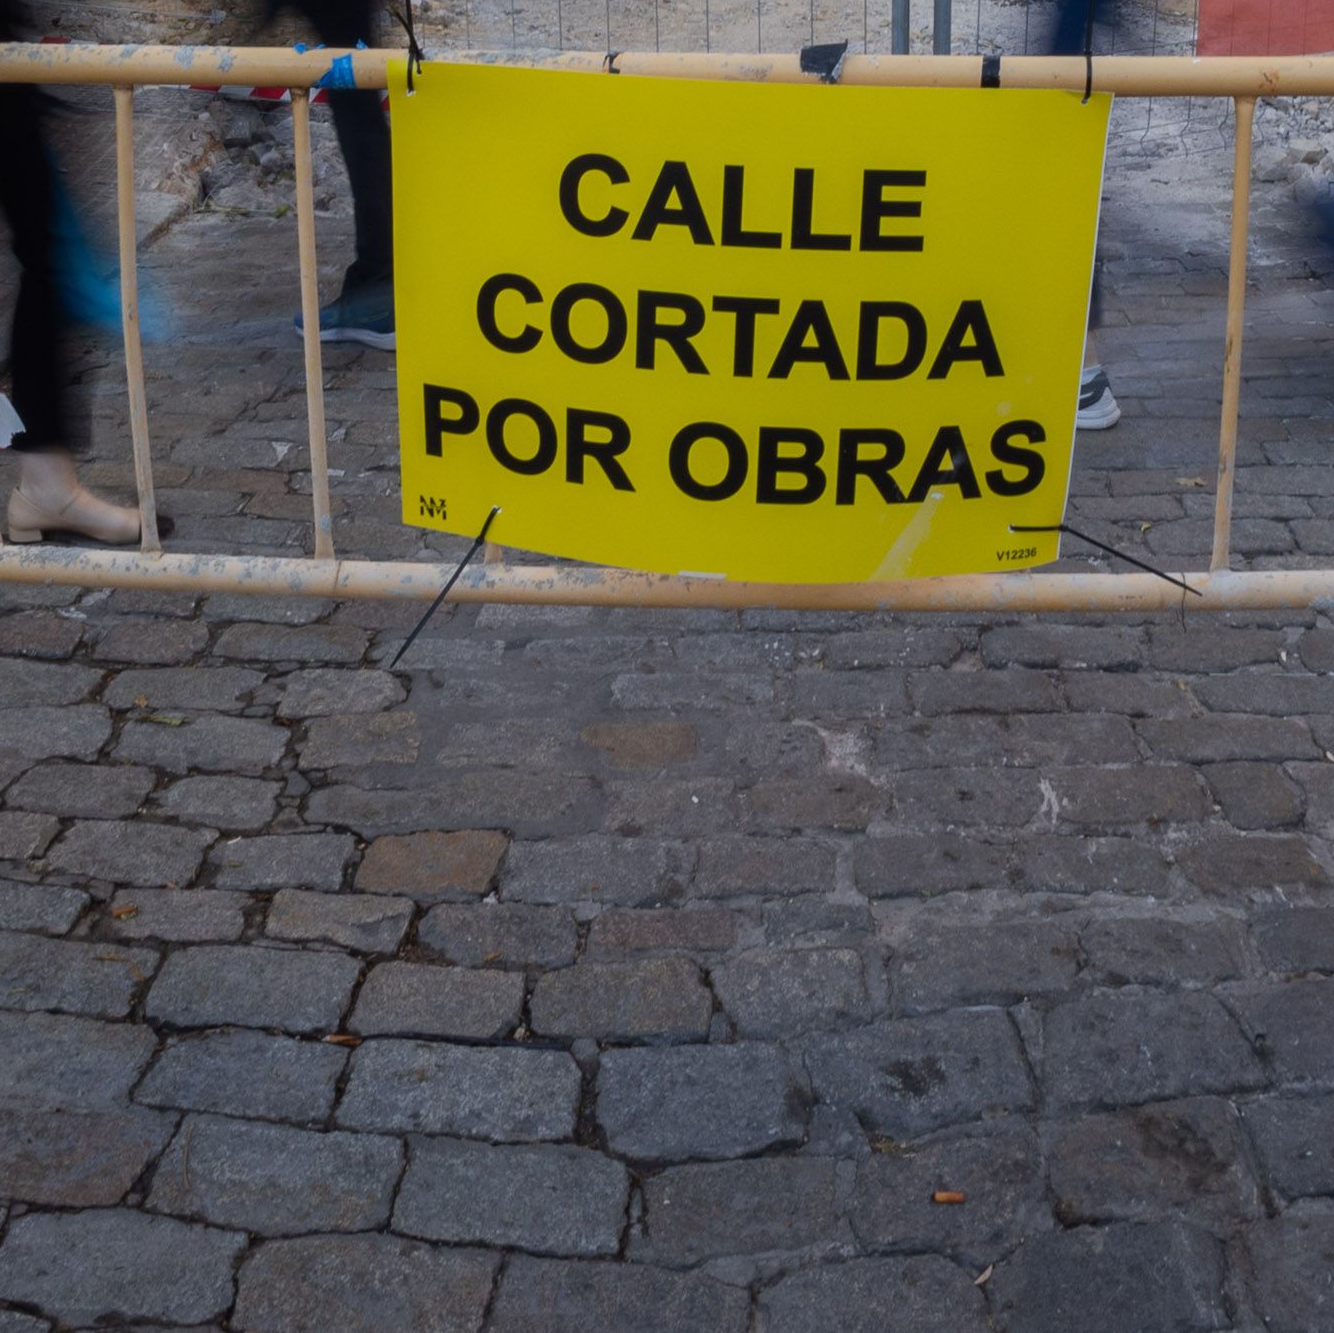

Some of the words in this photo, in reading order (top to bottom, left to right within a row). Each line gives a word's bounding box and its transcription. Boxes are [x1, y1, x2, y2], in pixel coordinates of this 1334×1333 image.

[559, 153, 927, 252] CALLE
[476, 272, 1006, 382] CORTADA
[423, 382, 636, 493] POR
[668, 418, 1047, 506] OBRAS
[996, 547, 1037, 562] V12236
